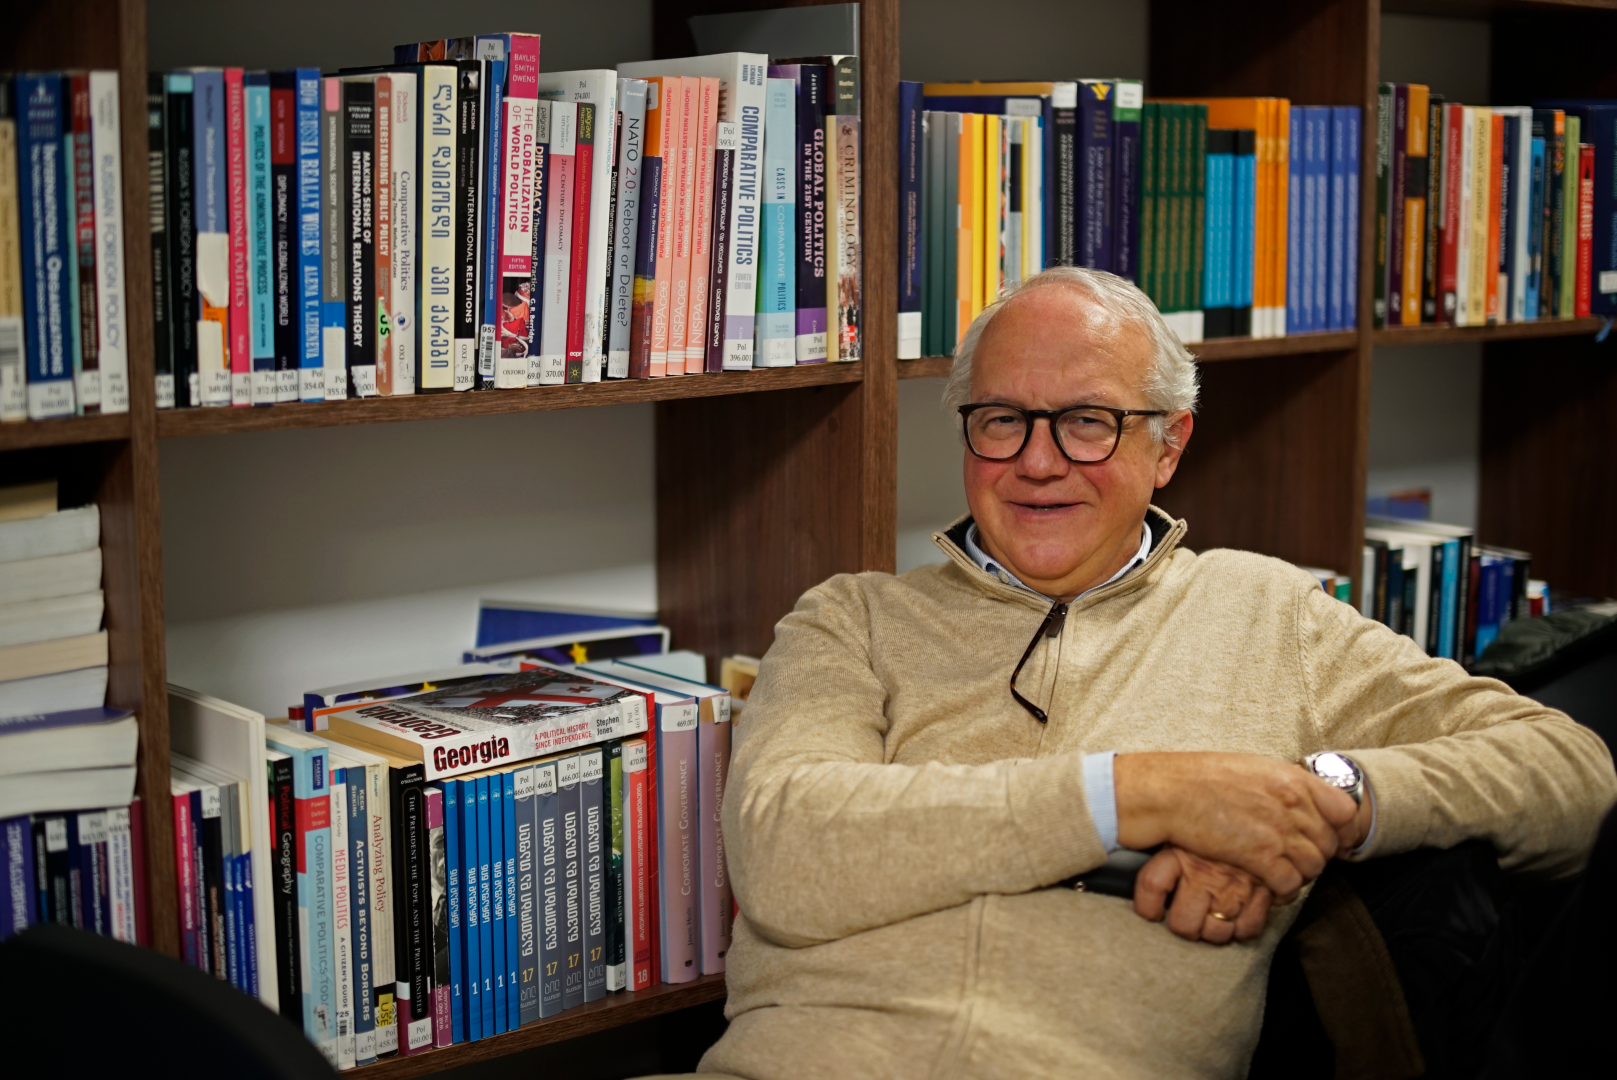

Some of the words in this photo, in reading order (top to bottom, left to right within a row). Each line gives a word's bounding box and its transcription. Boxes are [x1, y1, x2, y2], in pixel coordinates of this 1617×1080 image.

[514, 53, 536, 62] BAYLIS
[514, 64, 535, 72] SMITH
[300, 80, 319, 106] HOW
[512, 75, 536, 83] OWENS
[810, 74, 818, 104] Jackson
[432, 85, 452, 136] ლარი
[512, 105, 522, 122] OF
[683, 86, 691, 116] EUROPE:
[703, 84, 711, 114] EUROPE:
[301, 110, 319, 156] RUSSIA
[524, 106, 534, 132] THE
[539, 107, 548, 140] palgrave
[584, 107, 593, 140] palgrave
[682, 118, 690, 148] EASTERN
[701, 115, 709, 146] EASTERN
[380, 107, 389, 186] UNDERSTANDING
[510, 124, 521, 170] WORLD
[625, 118, 640, 162] NATO
[738, 106, 760, 202] COMPARATIVE
[804, 143, 812, 156] IN
[362, 151, 371, 194] MAKING
[580, 149, 589, 180] Qualitative
[699, 164, 707, 194] CENTRAL
[776, 168, 786, 190] CASES
[804, 158, 812, 182] THE
[814, 128, 824, 196] GLOBAL
[100, 154, 116, 218] RUSSIAN
[301, 159, 319, 210] REALLY
[352, 151, 361, 240] INTERNATIONAL
[431, 146, 452, 238] დაიმონდი
[520, 134, 533, 234] GLOBALIZATION
[532, 146, 544, 218] DIPLOMACY:
[579, 182, 587, 204] Methods
[610, 172, 618, 196] Politics
[624, 167, 638, 194] 2.0:
[679, 166, 687, 196] CENTRAL
[776, 192, 786, 200] IN
[804, 184, 812, 208] 21ST
[362, 197, 371, 228] SENSE
[380, 188, 389, 222] PUBLIC
[398, 171, 410, 248] Comparative
[508, 174, 520, 230] POLITICS
[697, 205, 705, 230] POLICY
[844, 144, 856, 270] CRIMINOLOGY
[301, 212, 320, 256] WORKS
[362, 230, 372, 244] OF
[380, 224, 389, 256] POLICY
[466, 186, 476, 264] INTERNATIONAL
[531, 218, 541, 242] Theory
[577, 212, 586, 246] International
[607, 203, 617, 244] International
[621, 200, 636, 250] Reboot
[736, 205, 756, 266] POLITICS
[804, 211, 812, 264] CENTURY
[814, 201, 824, 278] POLITICS
[102, 222, 119, 288] FOREIGN
[531, 245, 540, 260] and
[576, 246, 584, 270] Relations
[696, 231, 704, 256] PUBLIC
[776, 206, 786, 278] COMPARATIVE
[352, 242, 362, 302] RELATIONS
[399, 250, 410, 292] Politics
[530, 261, 539, 292] Practice
[606, 246, 614, 278] Relations
[620, 255, 634, 268] or
[430, 266, 450, 296] ავი
[466, 265, 474, 324] RELATIONS
[777, 282, 787, 312] POLITICS
[617, 275, 633, 328] Delete?
[655, 280, 669, 349] NISPAcee
[672, 279, 687, 347] NISPAcee
[692, 276, 706, 343] NISPAcee
[104, 295, 121, 350] POLICY
[352, 304, 362, 348] THEORY
[430, 305, 450, 368] ქარები
[736, 343, 747, 351] Pol
[539, 727, 566, 740] POLITICAL
[566, 722, 589, 733] HISTORY
[596, 716, 620, 728] Stephen
[596, 726, 613, 736] Jones
[433, 735, 510, 772] Georgia
[535, 741, 551, 750] SINCE
[552, 731, 592, 746] INDEPENDENCE
[280, 785, 292, 830] Political
[408, 795, 417, 812] THE
[678, 760, 690, 830] GOVERNANCE
[371, 815, 386, 876] Analyzing
[409, 815, 418, 862] PRESIDENT,
[543, 817, 555, 866] თაფლი
[564, 811, 577, 859] თაფლი
[587, 806, 599, 853] თაფლი
[281, 832, 294, 896] Geography
[518, 823, 531, 872] თაფლი
[589, 855, 600, 871] და
[334, 849, 347, 882] MEDIA
[356, 840, 367, 906] ACTIVISTS
[411, 864, 419, 880] THE
[521, 874, 531, 889] და
[544, 868, 556, 885] და
[566, 860, 577, 878] და
[680, 834, 691, 896] CORPORATE
[335, 886, 348, 930] POLITICS
[373, 877, 388, 914] Policy
[411, 883, 420, 908] POPE,
[566, 879, 579, 942] ნავთობი
[589, 873, 602, 936] ნავთობი
[358, 909, 368, 960] BEYOND
[412, 909, 420, 926] AND
[521, 892, 534, 956] ნავთობი
[544, 887, 557, 950] ნავთობი
[413, 928, 421, 946] THE
[590, 946, 602, 961] 17
[340, 945, 348, 982] CITIZEN'S
[413, 947, 422, 972] PRIME
[522, 967, 535, 982] 17
[546, 961, 558, 976] 17
[568, 953, 580, 968] 17
[637, 969, 648, 984] 18
[359, 963, 370, 1022] BORDERS
[414, 975, 423, 1014] MINISTER
